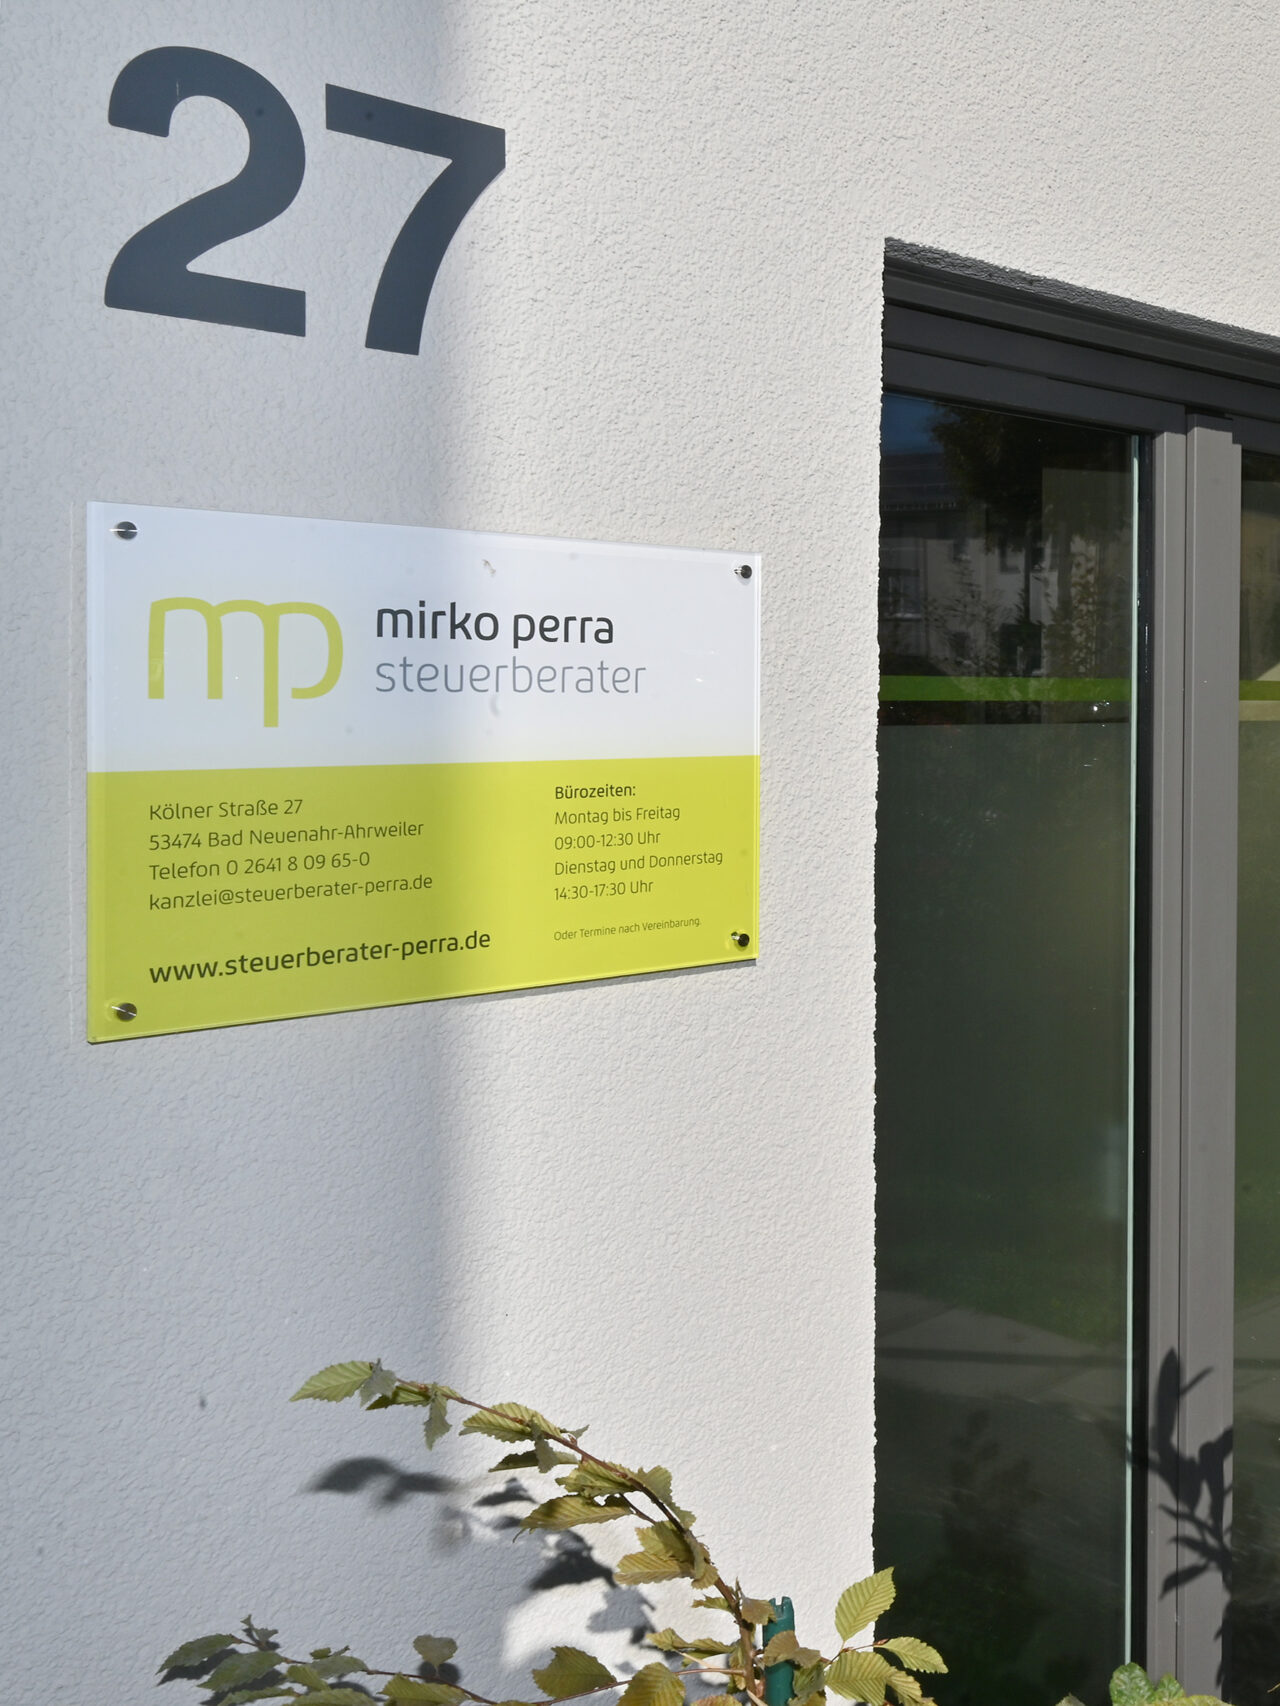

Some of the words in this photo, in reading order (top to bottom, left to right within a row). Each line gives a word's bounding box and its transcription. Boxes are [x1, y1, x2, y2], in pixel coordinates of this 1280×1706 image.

[104, 45, 506, 356] 27
[376, 600, 499, 641] mirko
[513, 613, 614, 649] perra
[147, 596, 344, 728] mp
[376, 655, 647, 694] steuerberater
[555, 783, 636, 800] Bürozeiten:
[149, 802, 213, 821] Kölner
[218, 800, 279, 818] Straße
[283, 799, 303, 815] 27
[554, 810, 609, 825] Montag
[613, 807, 632, 822] bis
[636, 806, 681, 821] Freitag
[149, 832, 202, 851] 53474
[208, 829, 243, 848] Bad
[250, 821, 425, 846] Neuenahr-Ahrweiler
[554, 832, 633, 850] 09:00-12:30
[638, 830, 661, 845] Uhr
[149, 861, 220, 880] Telefon
[226, 859, 239, 876] 0
[244, 857, 282, 875] 2641
[287, 856, 298, 872] 8
[303, 853, 326, 870] 09
[331, 851, 370, 868] 65-0
[554, 860, 616, 876] Dienstag
[620, 855, 645, 871] und
[649, 851, 723, 869] Donnerstag
[149, 874, 433, 911] kanzlei@steuerberater-perra.de
[554, 881, 626, 900] 14:30-17:30
[630, 879, 654, 895] Uhr
[553, 930, 578, 941] Oder
[580, 926, 616, 938] Termine
[618, 923, 640, 934] nach
[149, 930, 491, 984] www.steuerberater-perra.de
